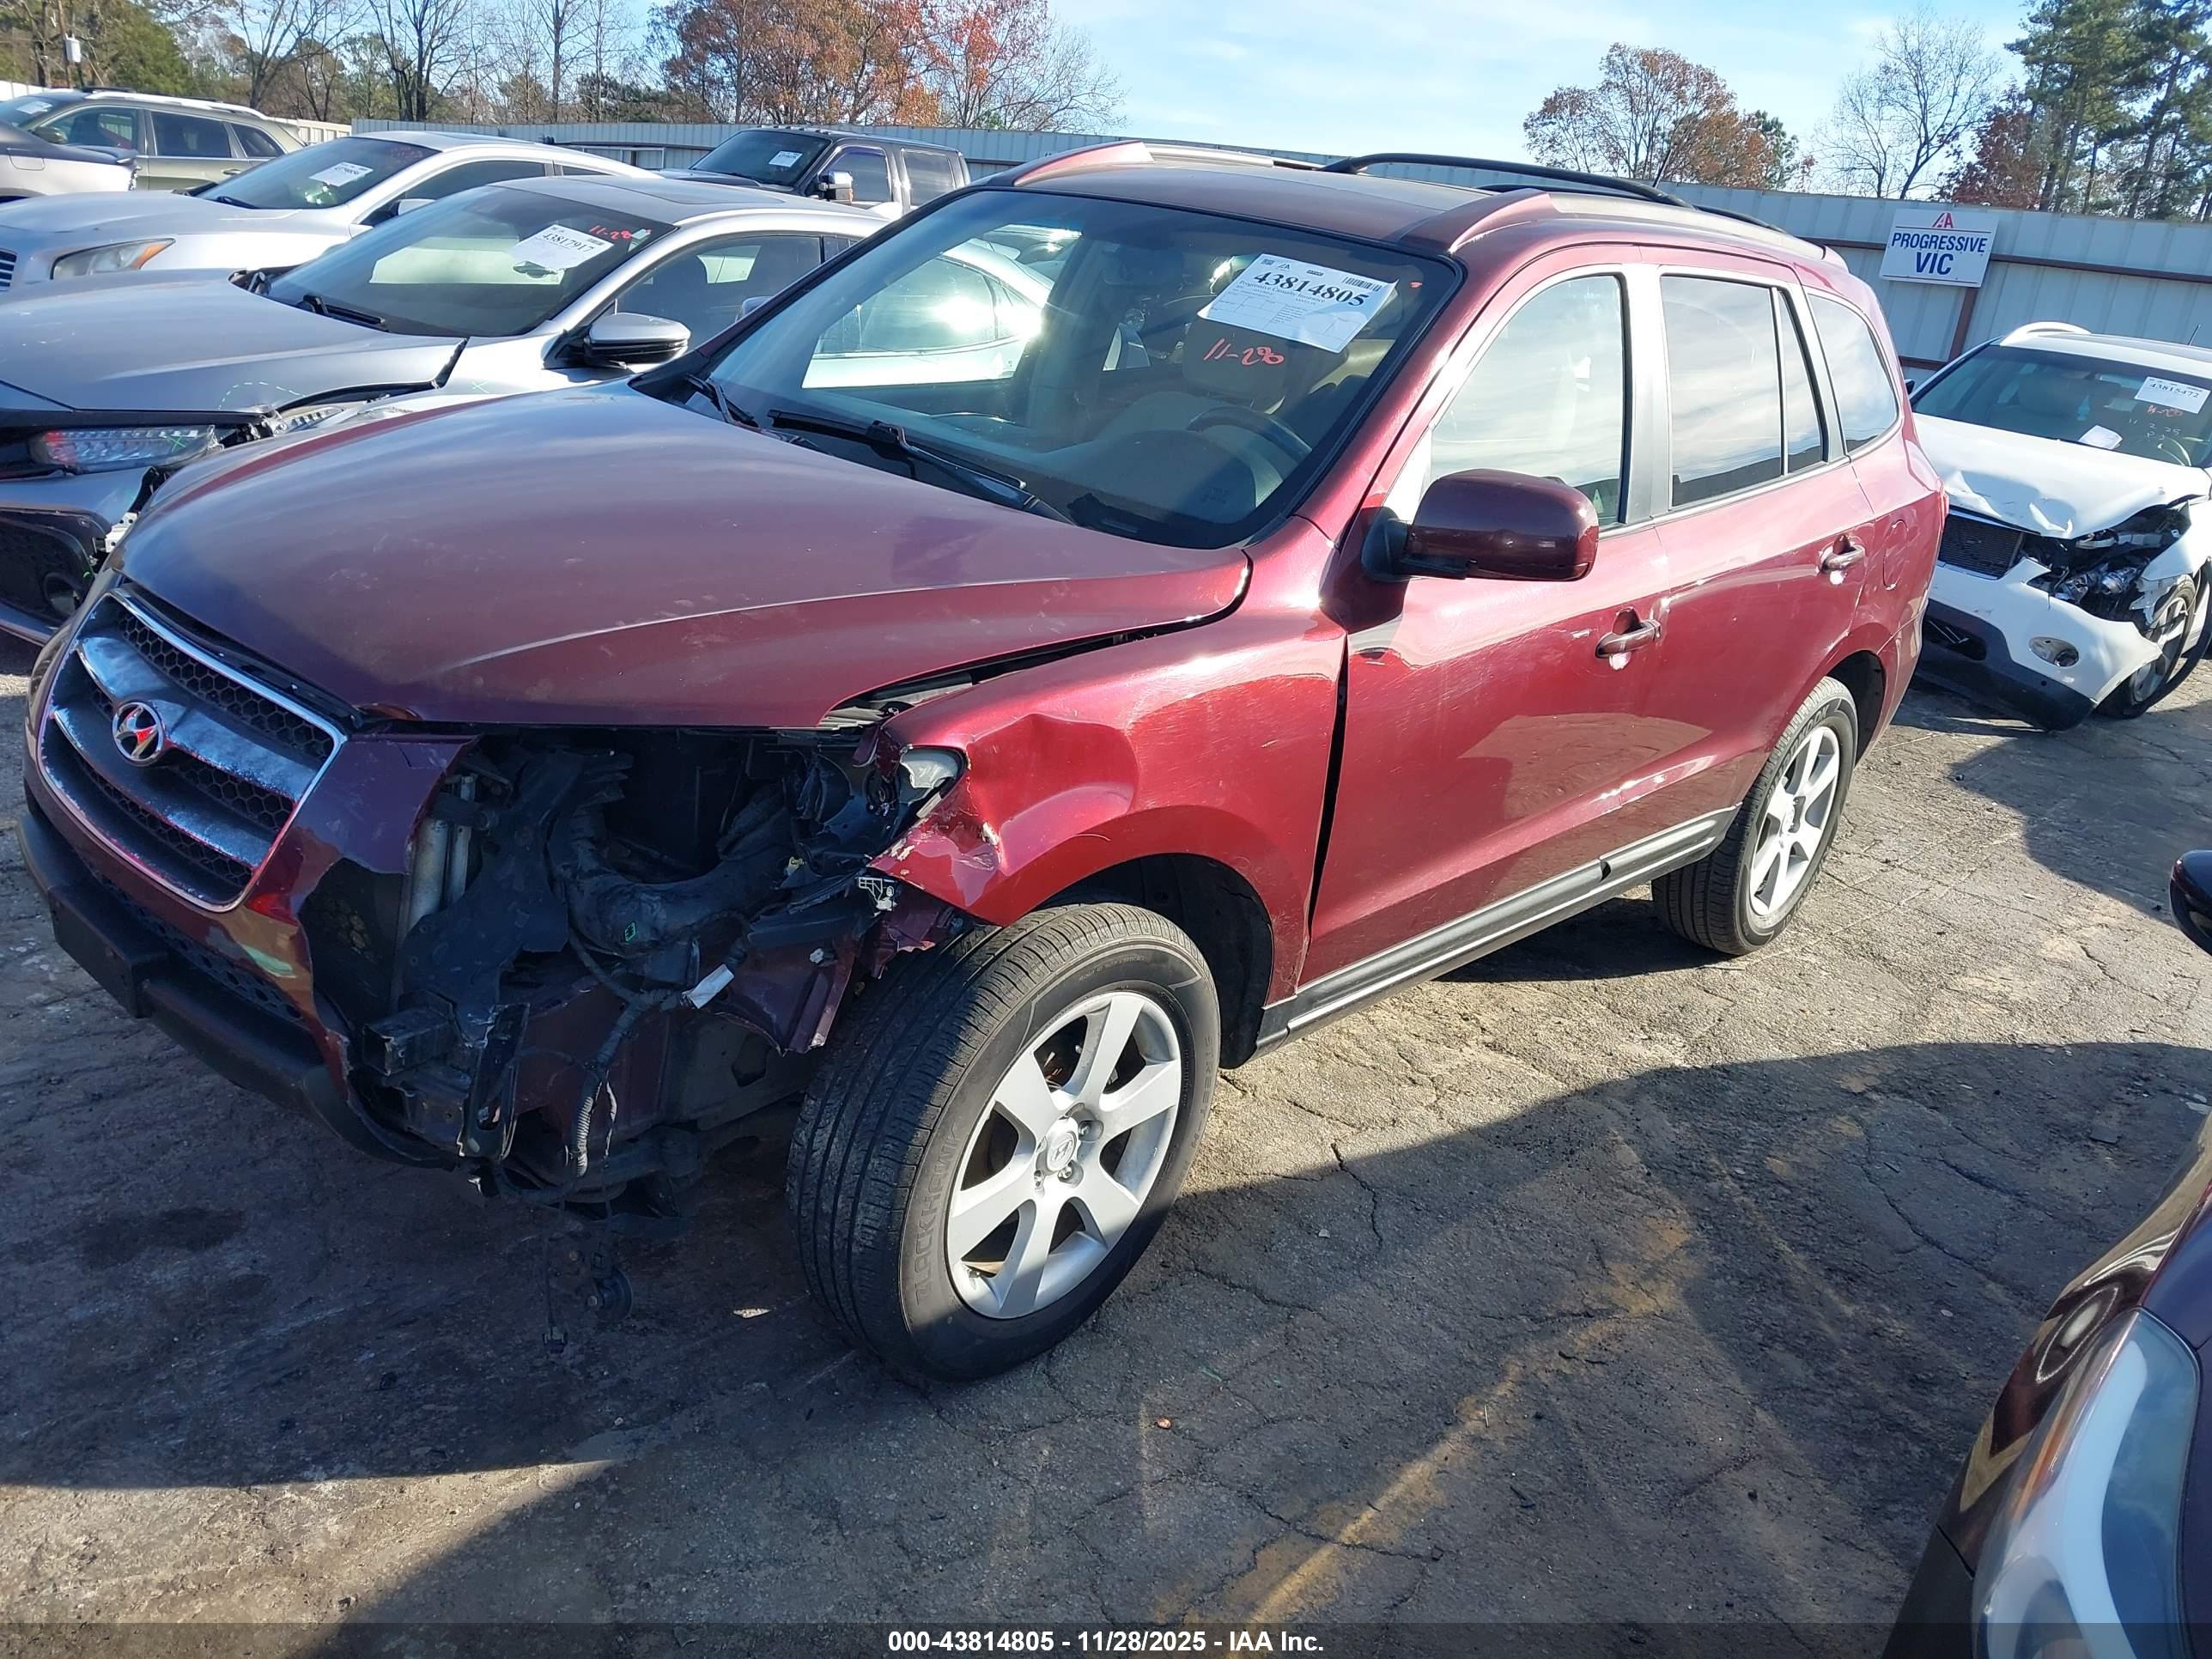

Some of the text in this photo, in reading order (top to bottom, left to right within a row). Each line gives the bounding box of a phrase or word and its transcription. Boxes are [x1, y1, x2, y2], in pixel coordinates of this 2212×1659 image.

[1892, 232, 1988, 253] PROGRESSIVE
[1916, 252, 1954, 276] VIC
[1254, 271, 1370, 307] 43814805
